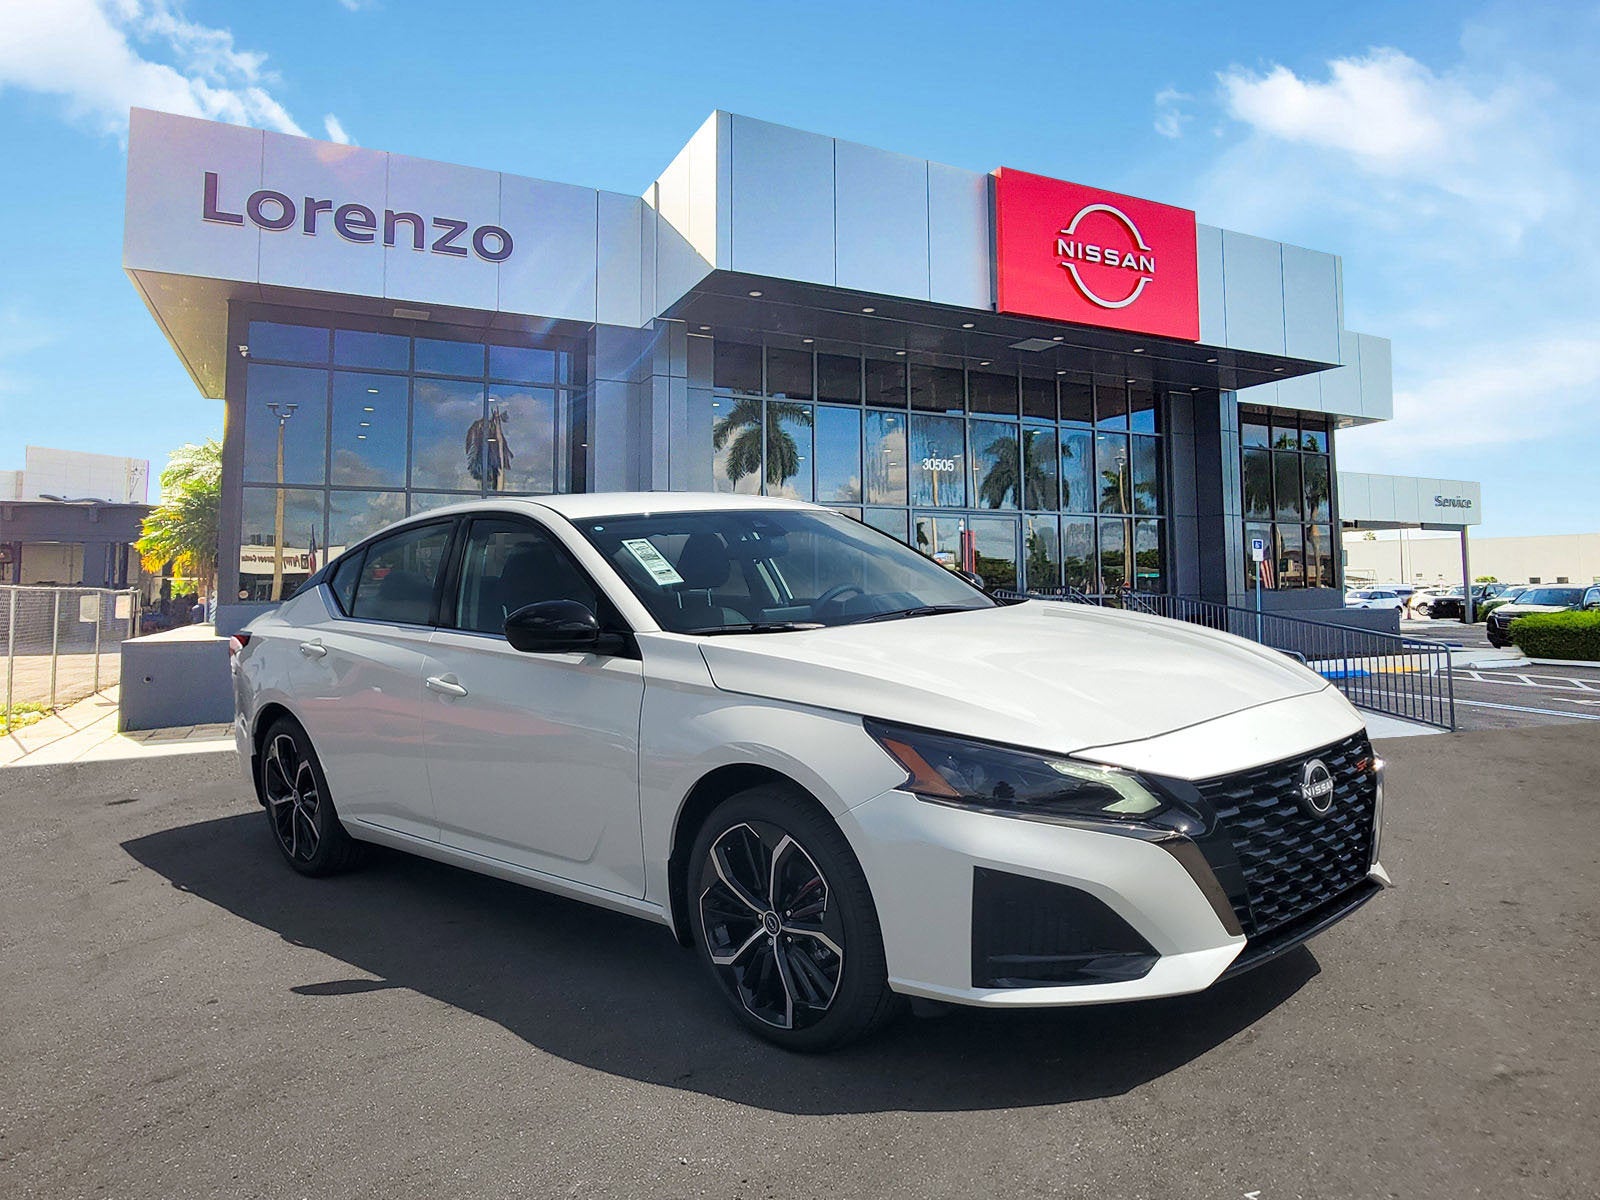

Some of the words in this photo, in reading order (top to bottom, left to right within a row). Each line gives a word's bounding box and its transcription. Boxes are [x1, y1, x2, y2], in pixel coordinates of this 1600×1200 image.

[202, 171, 514, 263] Lorenzo
[1057, 238, 1155, 273] NISSAN
[922, 457, 955, 471] 30505
[1434, 495, 1472, 509] Service
